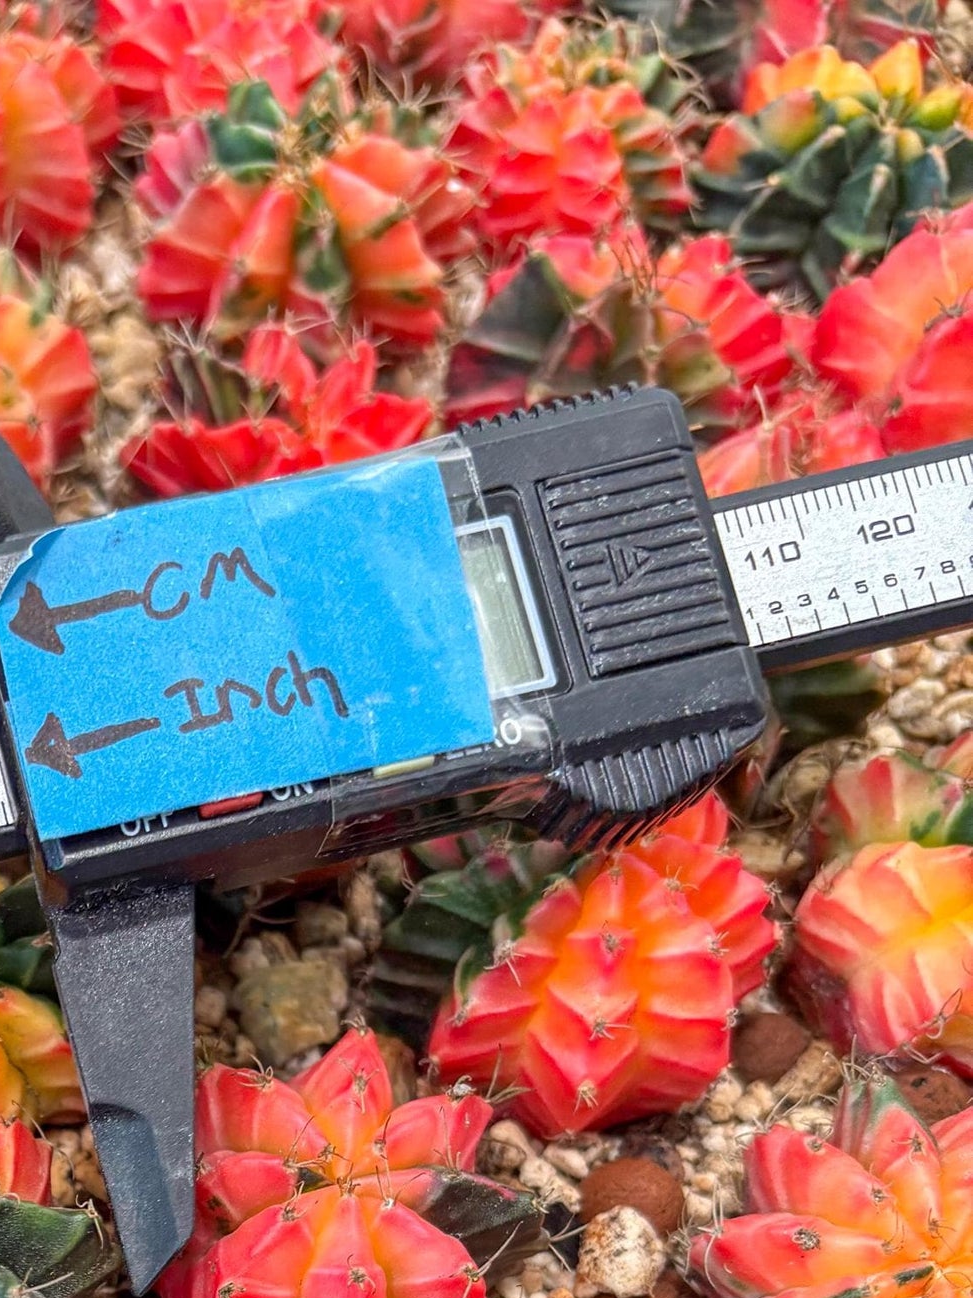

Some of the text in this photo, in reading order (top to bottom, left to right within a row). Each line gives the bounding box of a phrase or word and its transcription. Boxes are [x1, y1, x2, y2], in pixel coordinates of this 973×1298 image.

[744, 514, 915, 571] 110 120
[745, 608, 754, 619] 1
[768, 601, 784, 614] 2
[797, 594, 812, 607] 3
[827, 587, 840, 600] 4
[854, 580, 868, 594] 5
[883, 573, 898, 587] 6
[913, 566, 925, 580] 7
[940, 560, 956, 574] 8
[163, 650, 349, 734] Inch
